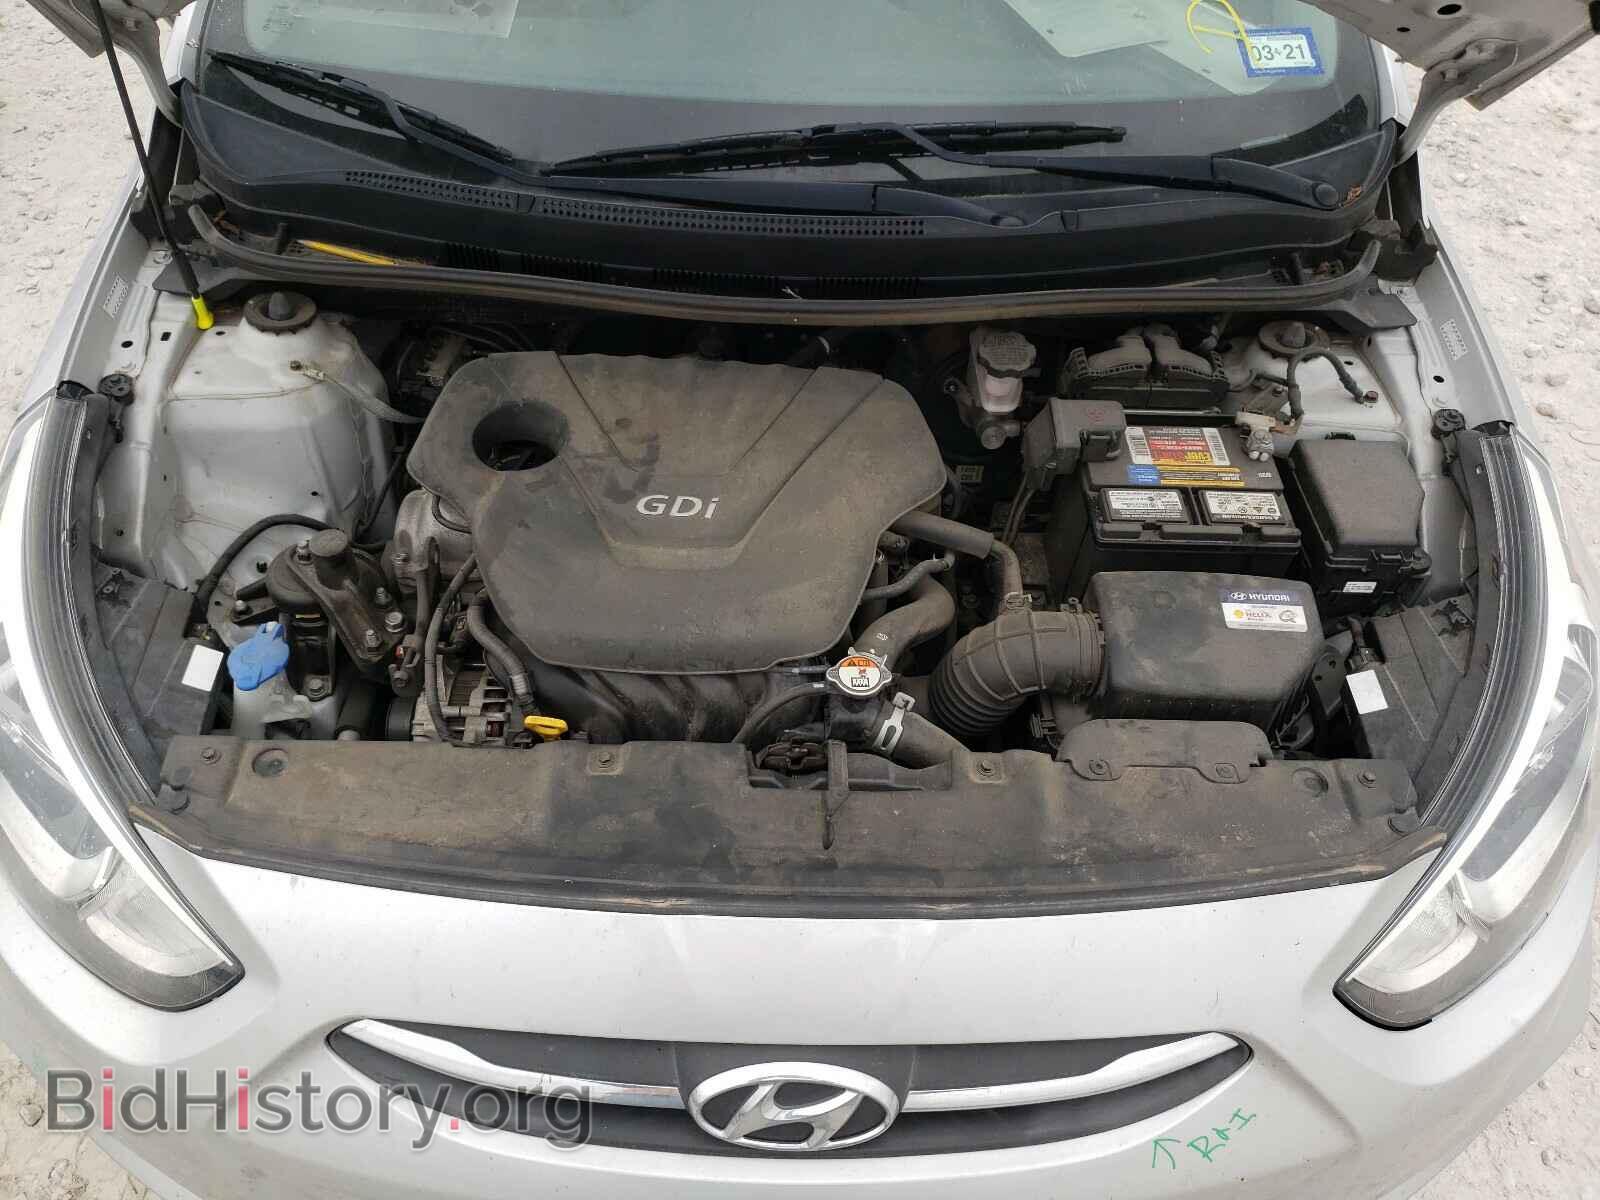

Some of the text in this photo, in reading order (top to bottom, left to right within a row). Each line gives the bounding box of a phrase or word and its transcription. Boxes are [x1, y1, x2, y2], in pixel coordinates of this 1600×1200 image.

[1283, 43, 1306, 60] 21
[635, 494, 720, 519] GDi
[1248, 593, 1291, 602] HYUNDAI
